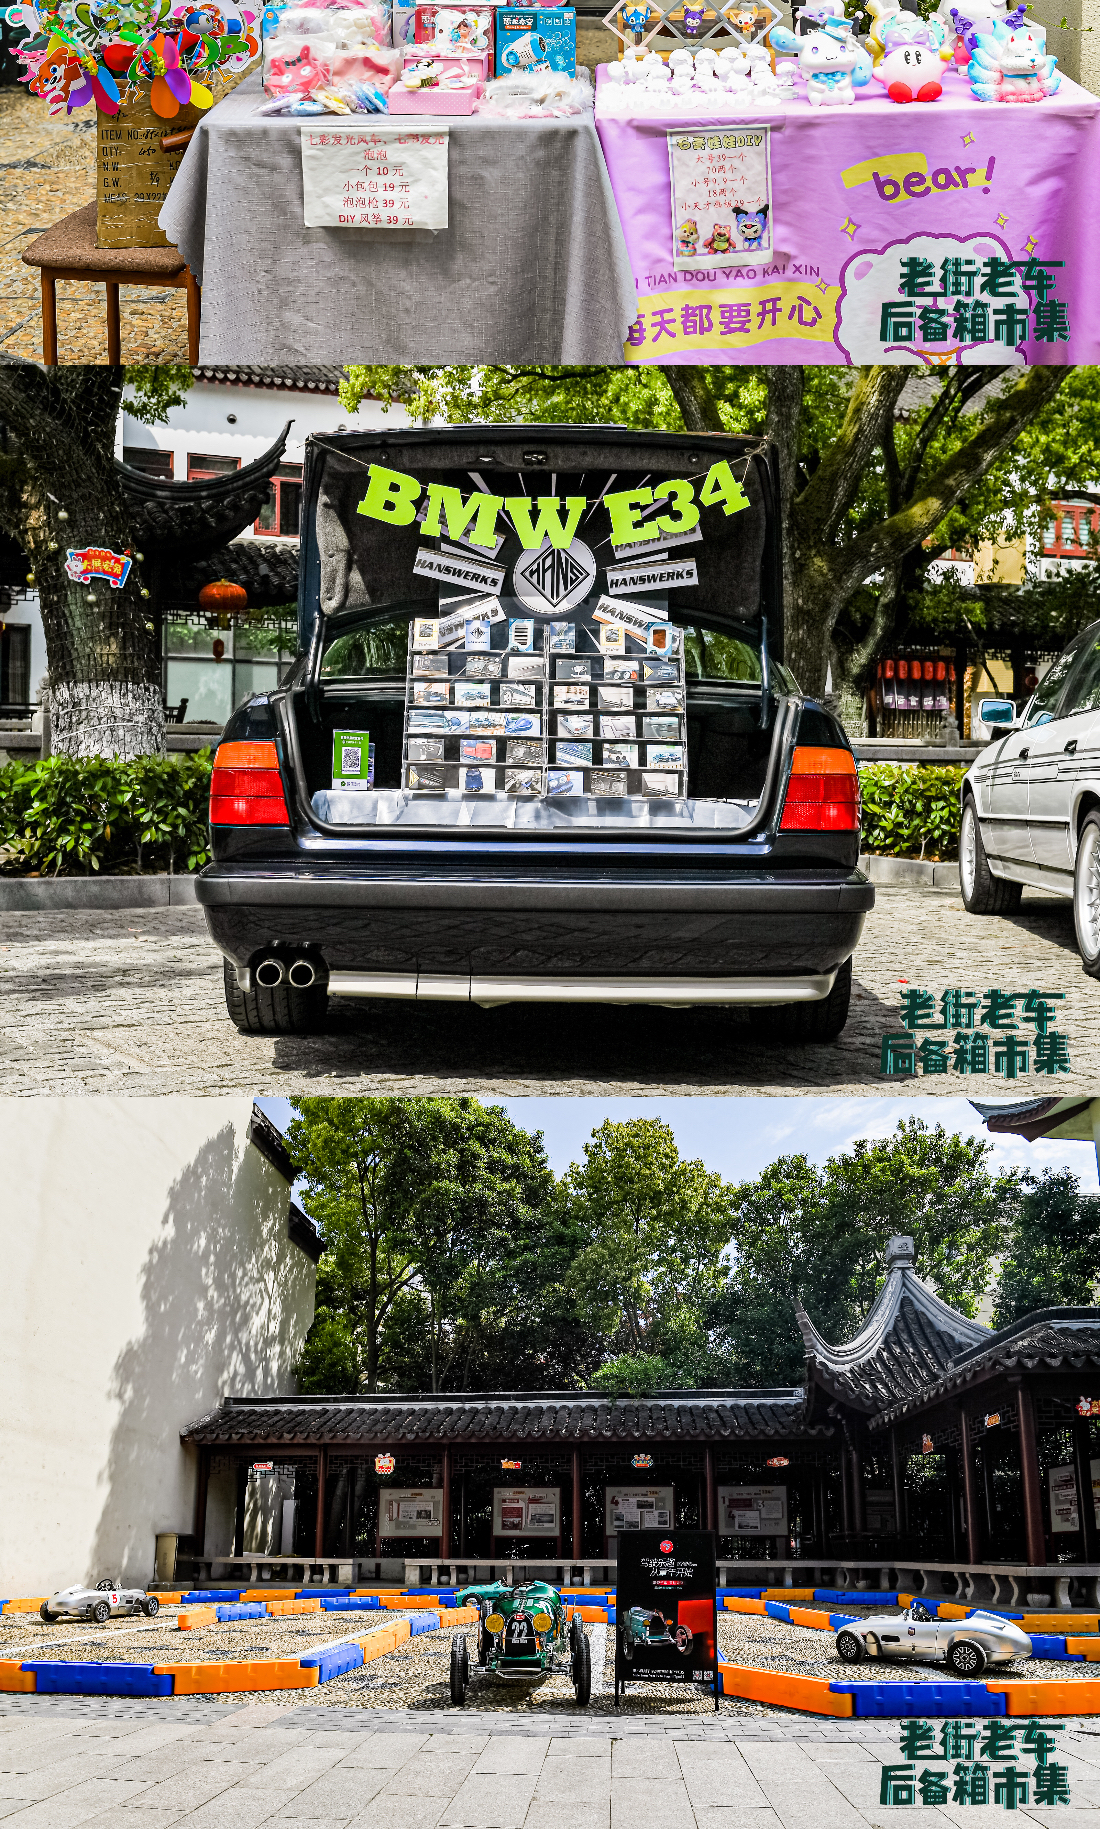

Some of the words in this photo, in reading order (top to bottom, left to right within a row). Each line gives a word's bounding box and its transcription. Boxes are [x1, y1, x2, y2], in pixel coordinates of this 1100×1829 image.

[101, 130, 122, 140] ITEM
[364, 149, 388, 161] 泡泡
[696, 152, 747, 163] 大号39一个
[103, 162, 121, 171] N.W.
[349, 165, 372, 176] 一个
[376, 167, 389, 175] 10
[392, 165, 404, 176] 元
[706, 164, 737, 174] 70两个
[104, 178, 121, 187] G.W.
[872, 156, 996, 201] bear!
[343, 181, 379, 192] 小包包
[382, 183, 395, 191] 19
[398, 182, 410, 192] 元
[708, 188, 737, 197] 18两个
[343, 197, 379, 209] 泡泡枪
[382, 199, 395, 208] 39
[398, 198, 410, 209] 元
[339, 215, 355, 223] DIY
[359, 213, 382, 225] 风筝
[386, 216, 399, 225] 39
[402, 215, 414, 225] 元
[646, 272, 677, 287] TIAN
[684, 270, 716, 282] DOU
[723, 269, 757, 281] YAO
[763, 265, 786, 276] KAI
[793, 264, 820, 277] XIN
[628, 296, 822, 346] 每天都要开心
[356, 464, 587, 549] BMW
[603, 461, 751, 546] E34
[416, 558, 500, 588] HANSWERKS
[610, 568, 695, 589] HANSWERKS
